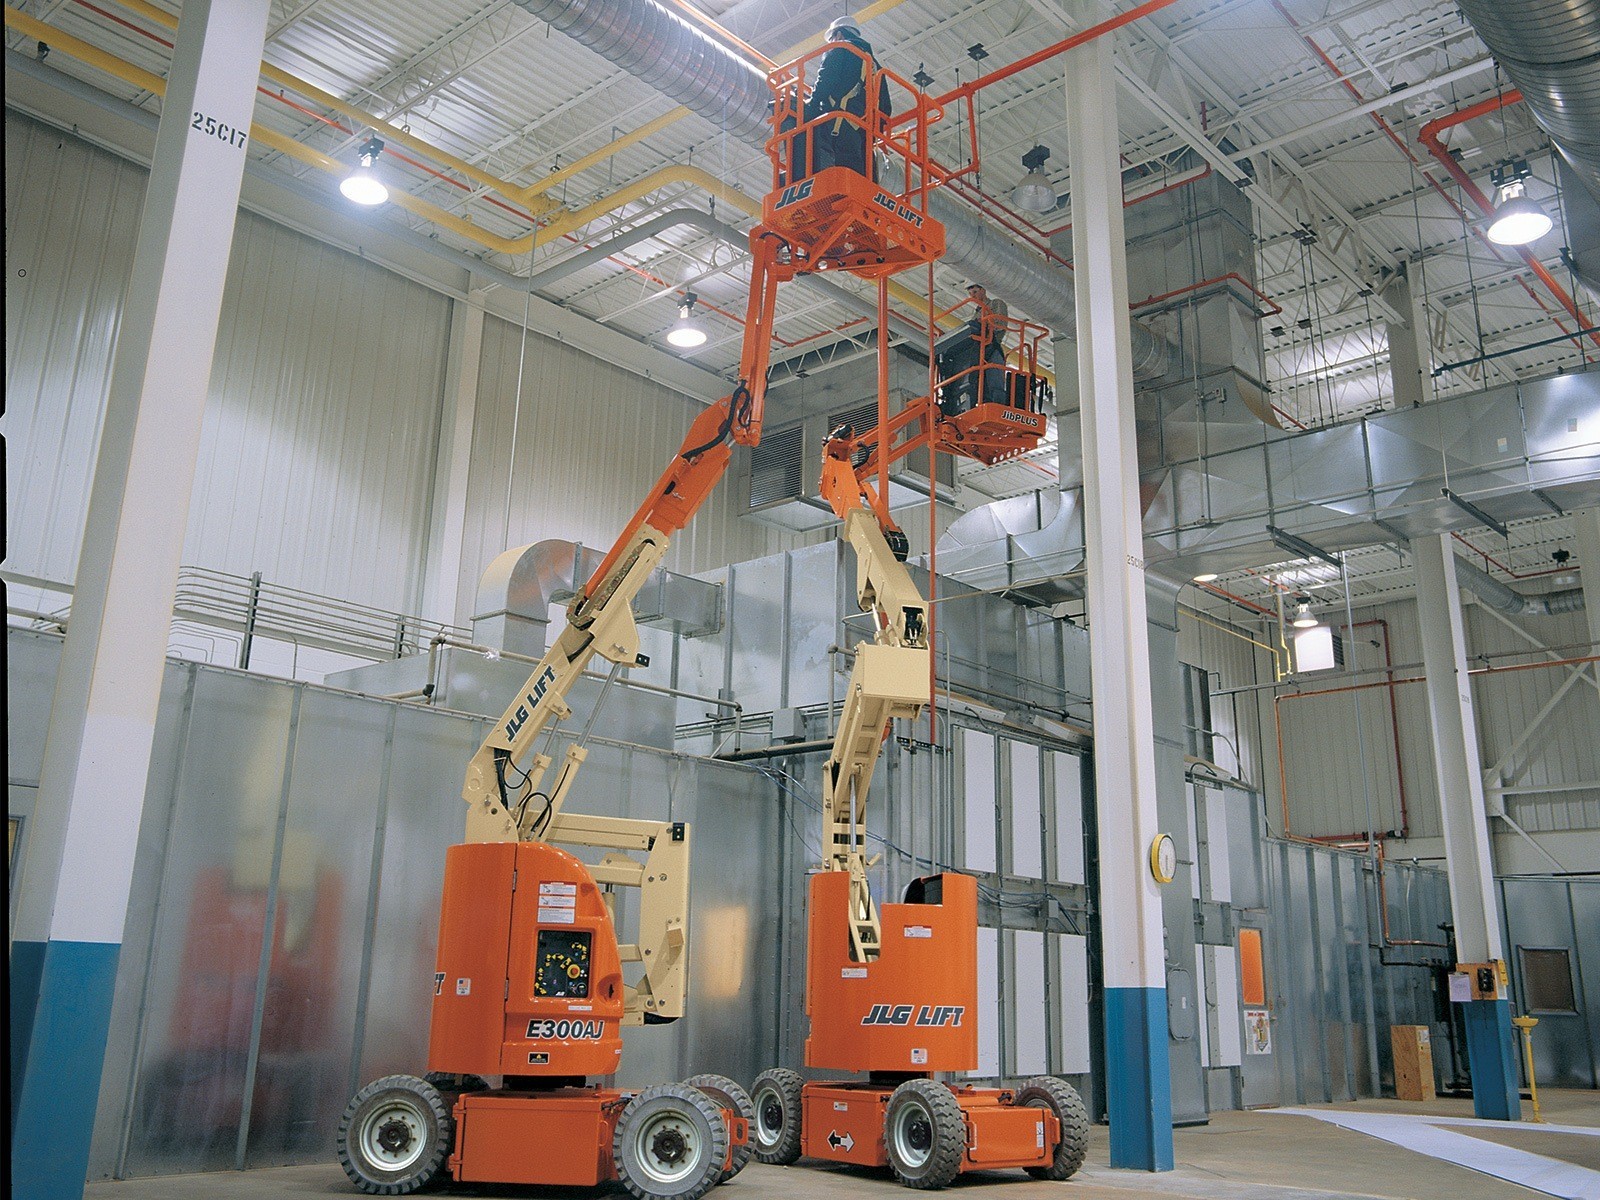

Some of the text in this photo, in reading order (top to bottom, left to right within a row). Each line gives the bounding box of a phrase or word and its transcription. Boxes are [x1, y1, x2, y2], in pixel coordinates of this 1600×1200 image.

[191, 111, 247, 149] 25C17
[774, 178, 815, 211] JLG
[873, 192, 924, 229] JLG LIFT
[1002, 410, 1038, 427] JibPLUS
[504, 664, 556, 743] JLG LIFT
[525, 1019, 605, 1040] E300AJ
[861, 1004, 965, 1027] JLG LIFT
